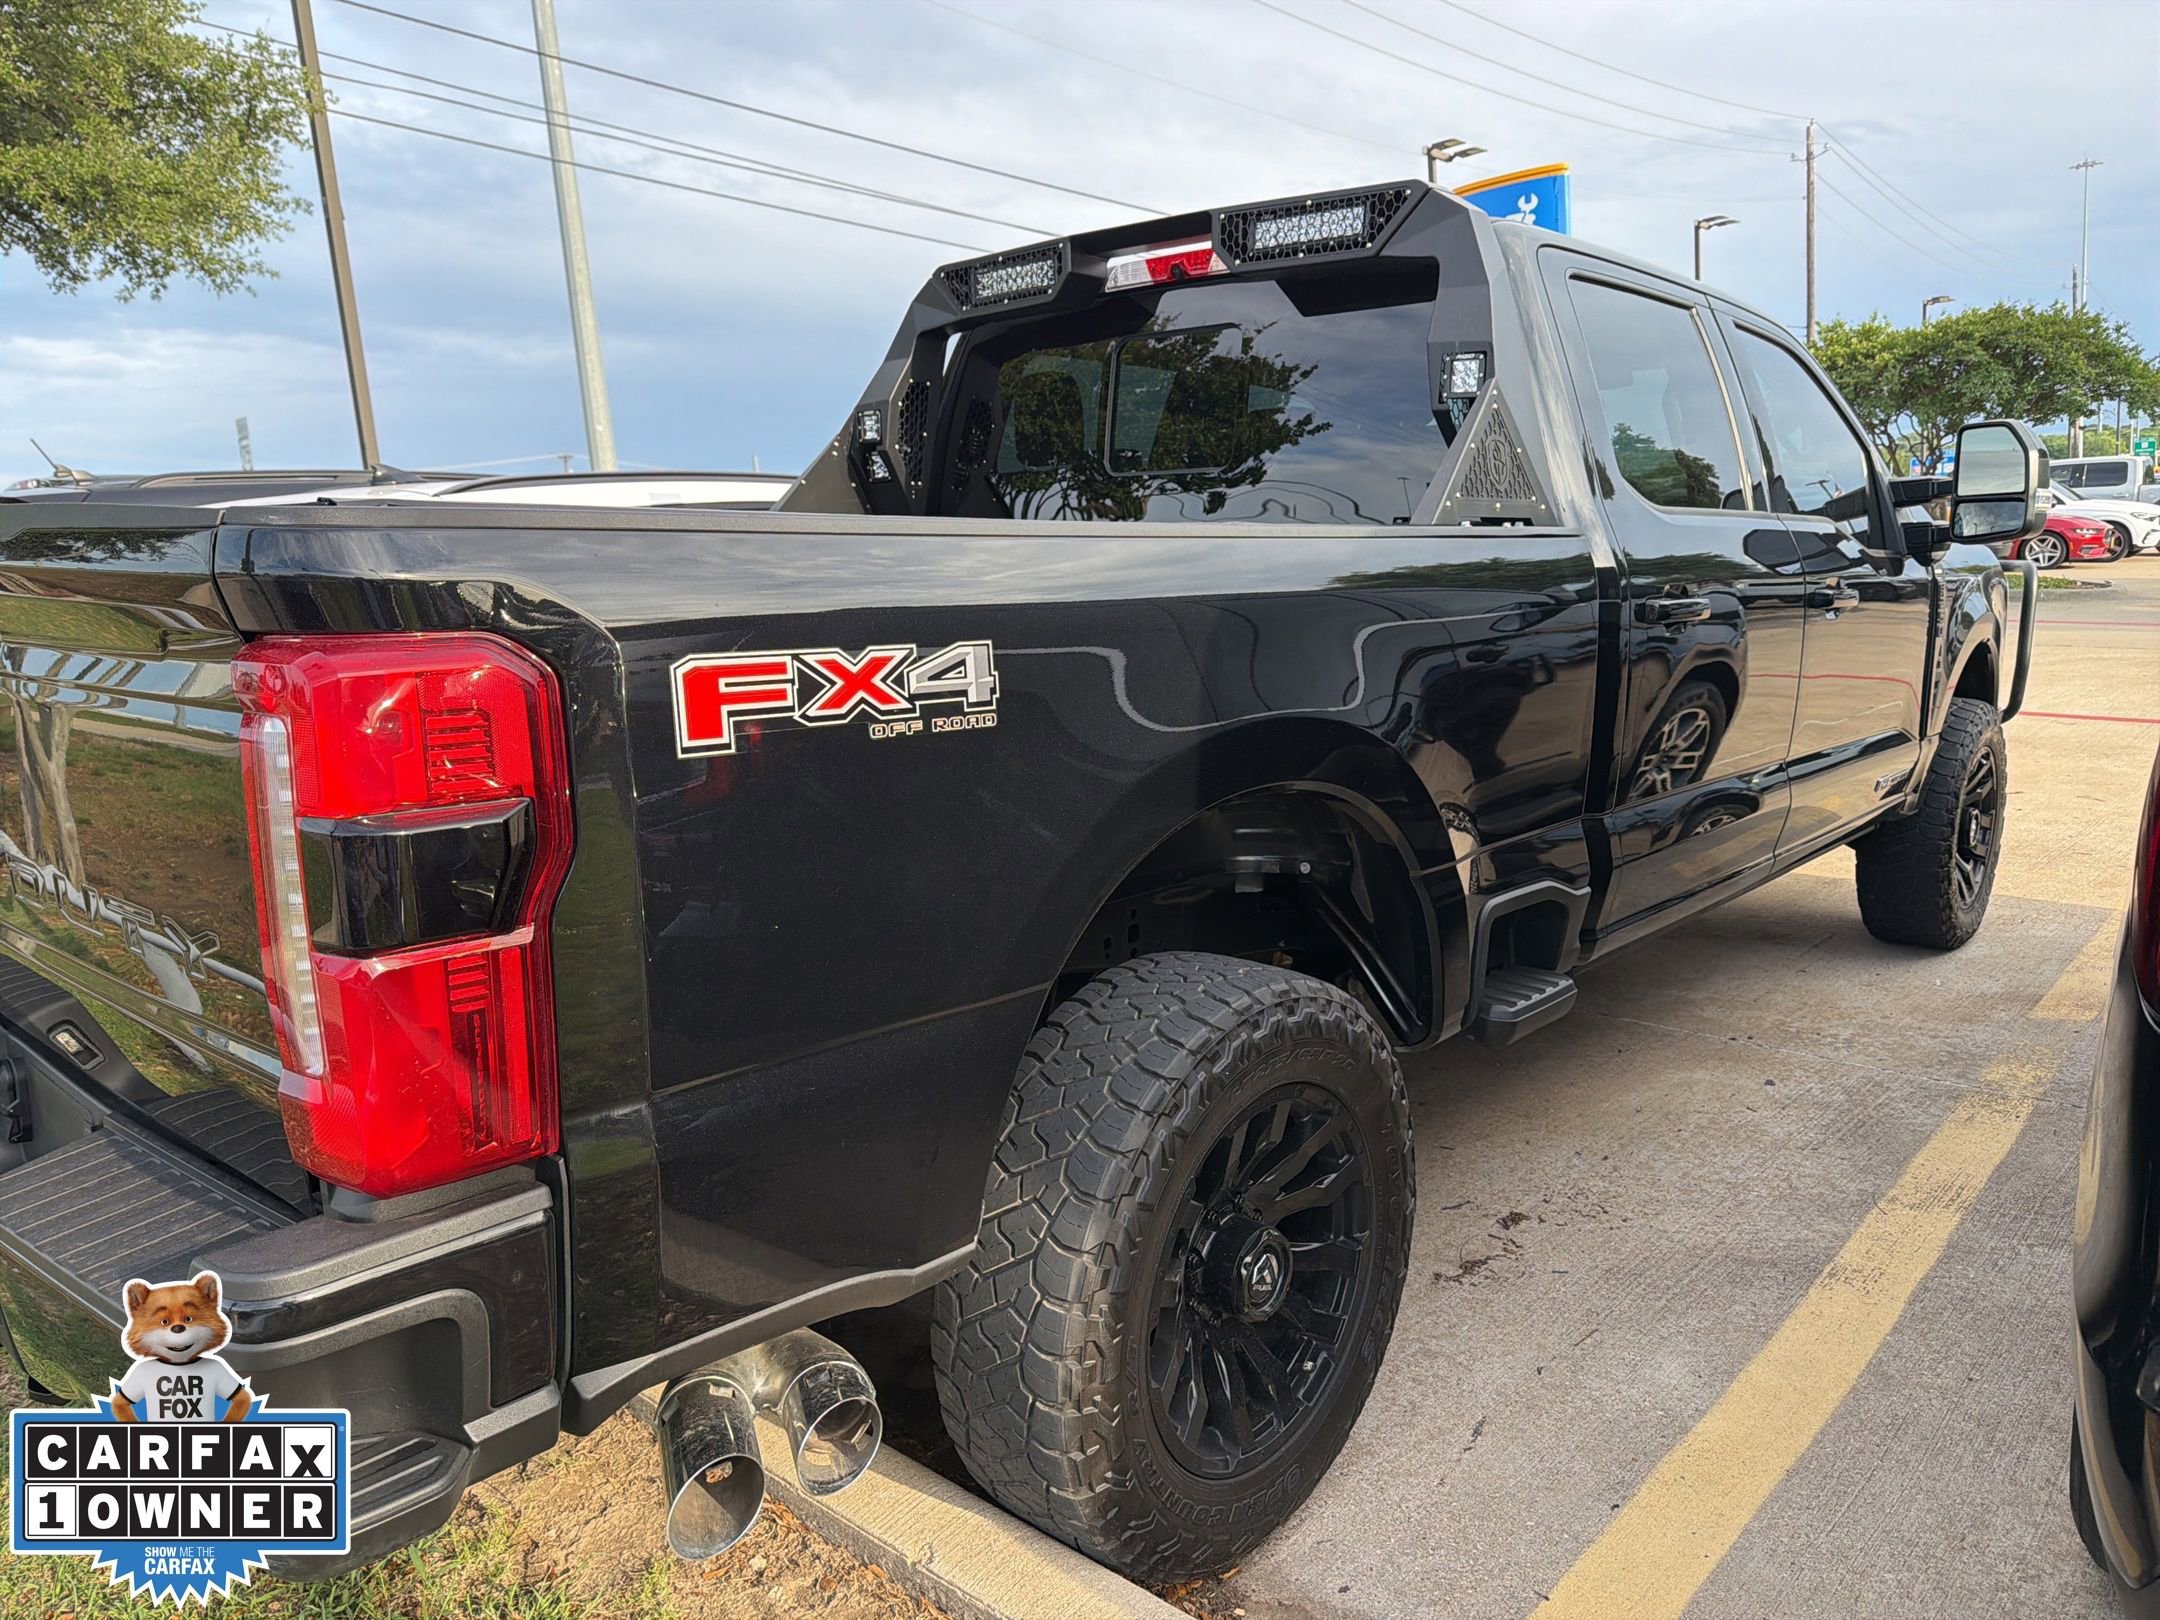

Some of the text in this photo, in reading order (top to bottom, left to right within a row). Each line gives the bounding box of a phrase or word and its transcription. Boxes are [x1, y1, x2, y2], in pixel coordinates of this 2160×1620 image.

[669, 640, 1000, 759] FX4
[869, 713, 998, 739] OFF ROAD
